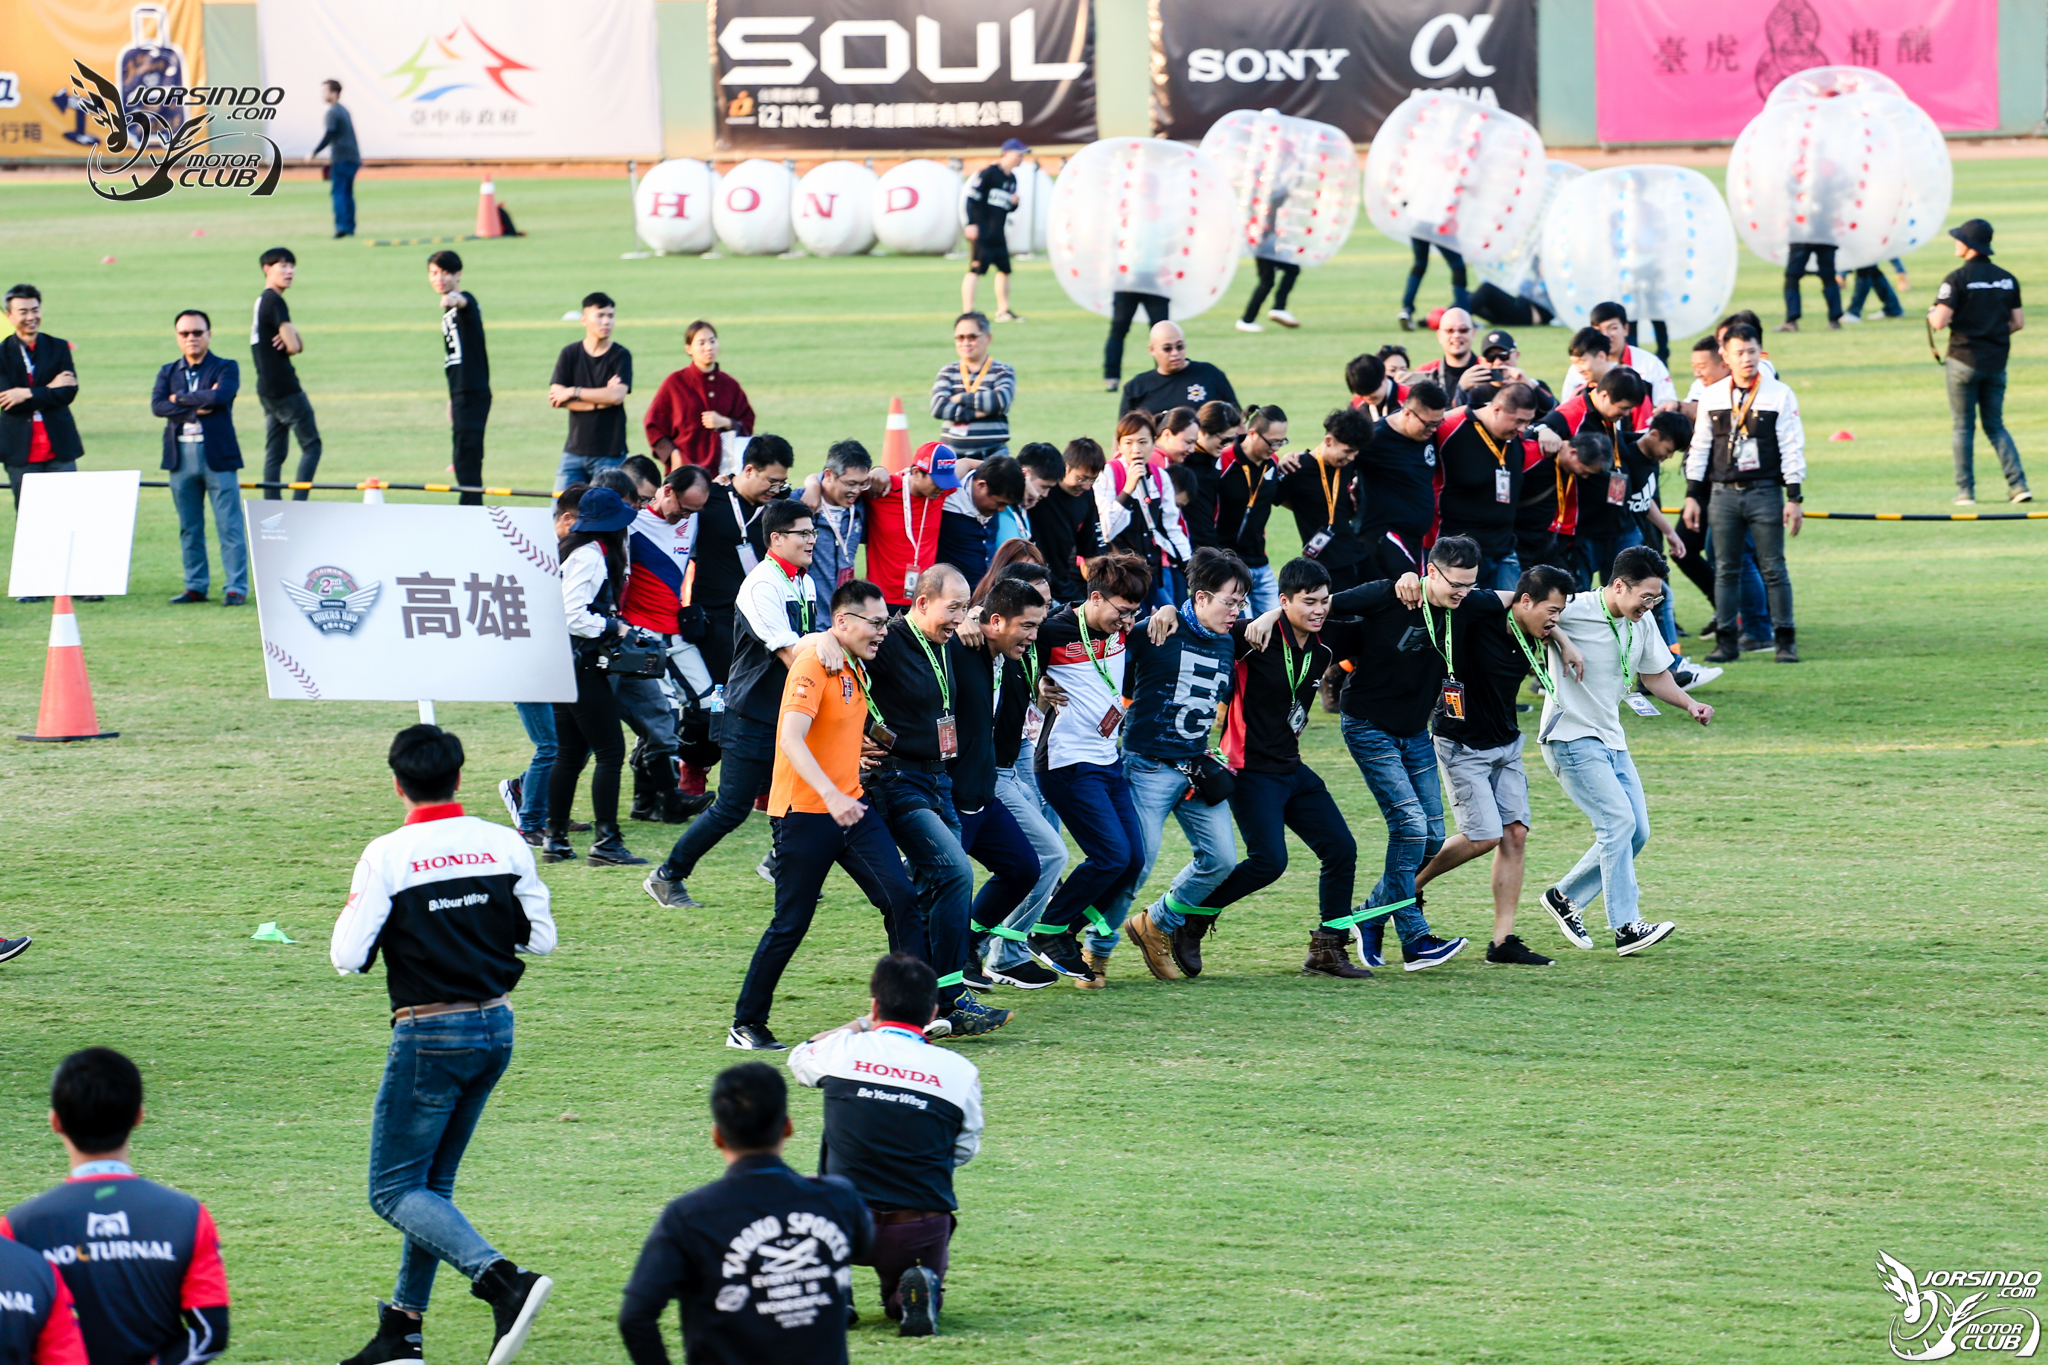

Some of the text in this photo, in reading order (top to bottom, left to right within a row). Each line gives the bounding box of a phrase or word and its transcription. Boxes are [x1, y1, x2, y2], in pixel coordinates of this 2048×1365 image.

[718, 8, 1087, 86] SOUL
[1187, 48, 1350, 83] SONY
[396, 571, 531, 641] 高雄
[410, 852, 498, 873] HONDA
[463, 893, 490, 906] Wing
[852, 1060, 943, 1088] HONDA
[857, 1087, 929, 1110] Be Your Wing
[43, 1240, 176, 1265] NOCTURNAL
